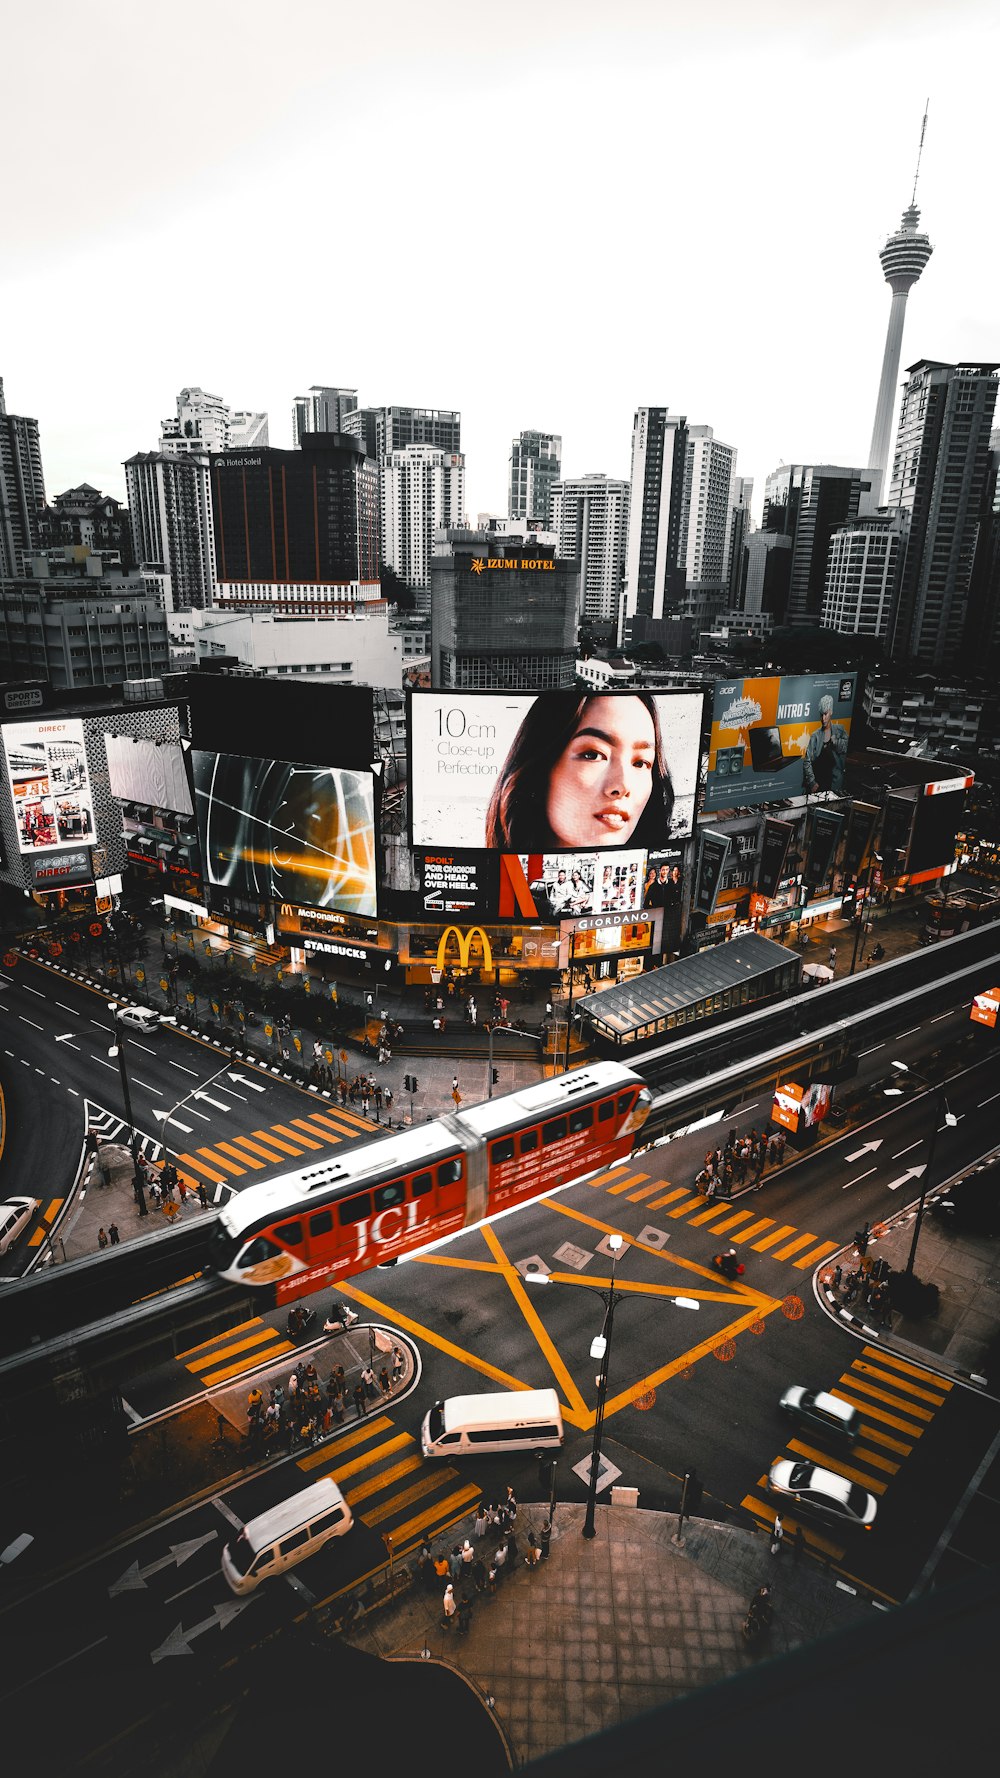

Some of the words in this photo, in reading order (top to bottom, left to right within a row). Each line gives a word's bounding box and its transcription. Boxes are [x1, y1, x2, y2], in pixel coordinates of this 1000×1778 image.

[226, 457, 243, 467] Hotel
[243, 457, 262, 466] Soleil
[487, 558, 518, 569] IZUMI
[521, 559, 556, 570] HOTEL
[7, 691, 40, 701] SPORTS
[719, 686, 737, 695] acer
[777, 703, 803, 719] NITRO
[804, 702, 811, 717] 5
[38, 725, 66, 733] DIRECT
[437, 741, 495, 758] Close-up
[437, 760, 498, 775] Perfection
[33, 852, 87, 870] SPORTS
[424, 855, 455, 865] SPOILT
[424, 864, 443, 873] FOR
[443, 864, 477, 874] CHOICE
[424, 872, 444, 880] AND
[444, 873, 469, 882] HEAD
[424, 880, 448, 889] OVER
[448, 881, 479, 890] HEELS.
[297, 907, 345, 924] McDonald's
[578, 912, 649, 930] GIORDANO
[303, 939, 367, 960] STARBUCKS
[512, 1177, 540, 1194] CREDIT
[540, 1164, 572, 1183] LEASING
[586, 1150, 603, 1163] BHD
[353, 1198, 431, 1263] JCL
